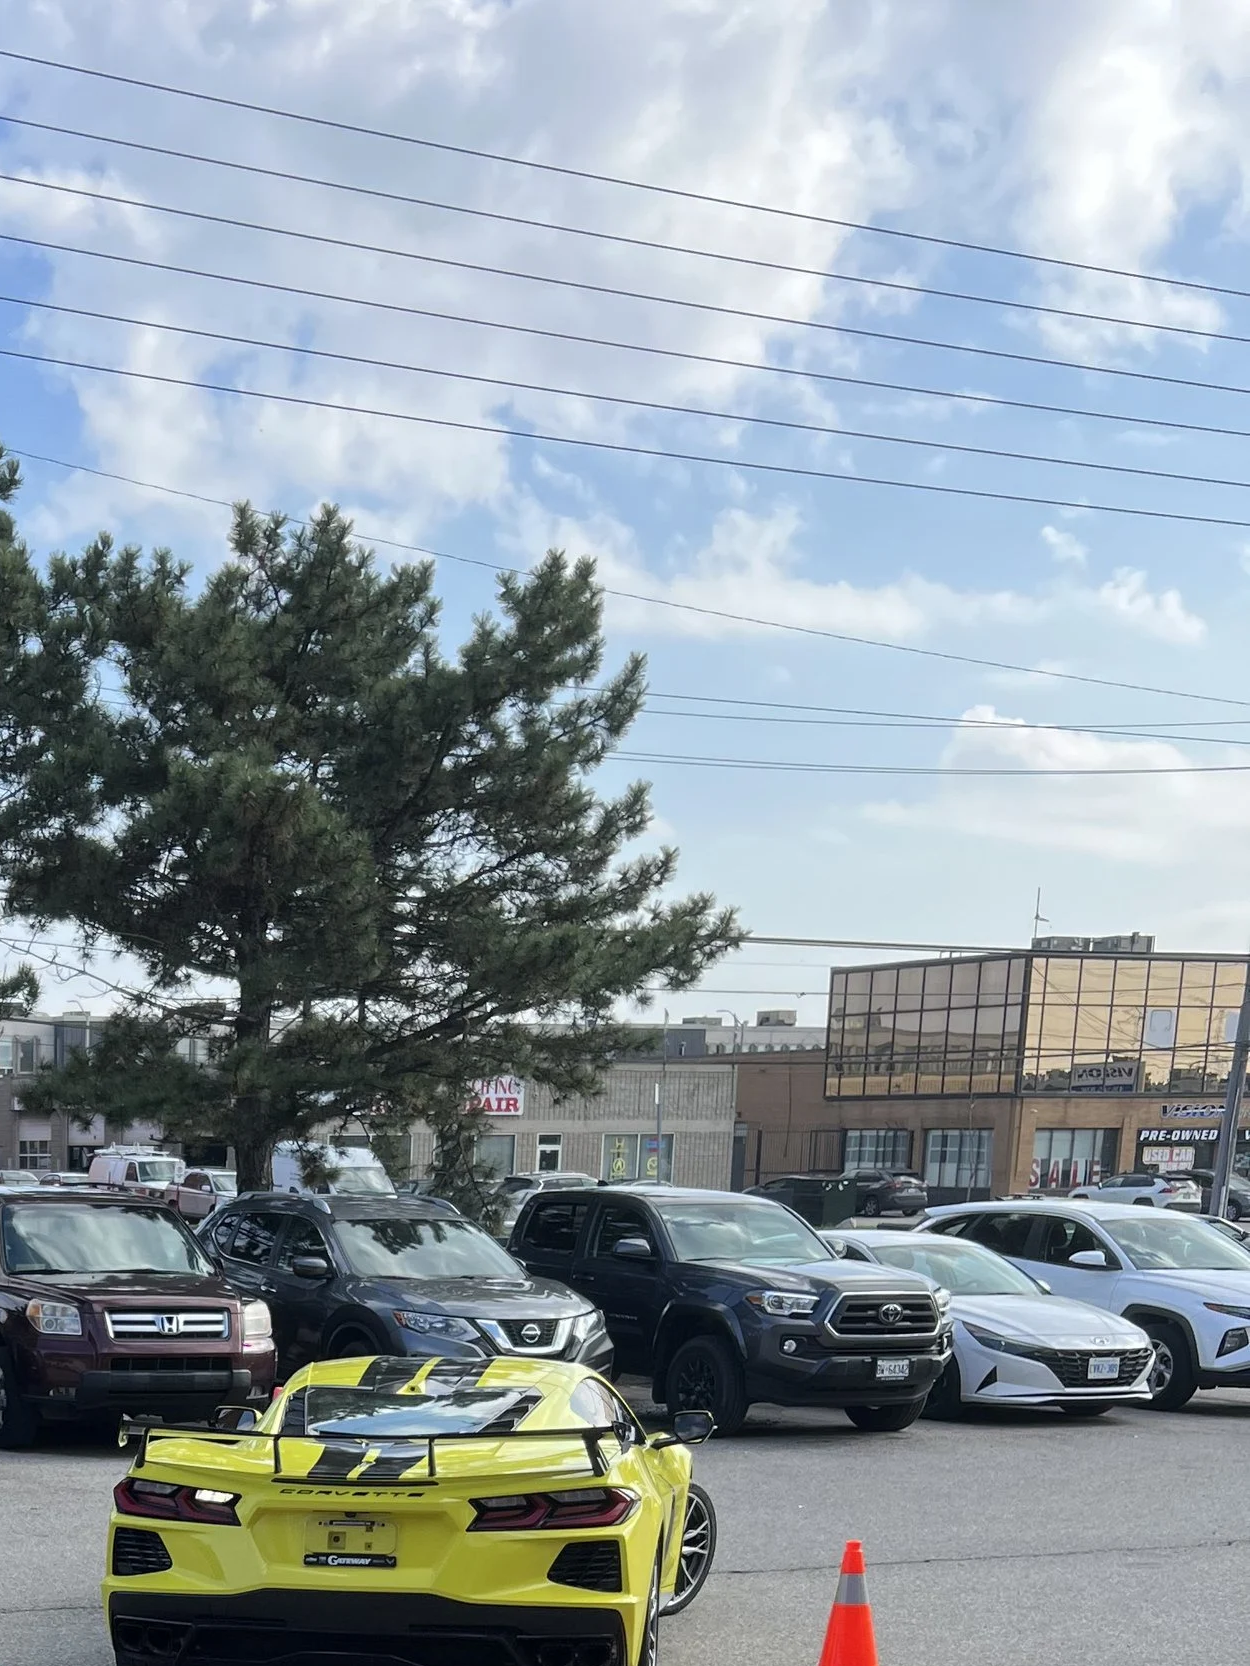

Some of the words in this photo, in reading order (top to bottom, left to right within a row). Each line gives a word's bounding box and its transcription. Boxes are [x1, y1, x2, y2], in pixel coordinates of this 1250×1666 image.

[1140, 1129, 1218, 1141] PRE-OWNED
[1028, 1159, 1100, 1187] SALE
[279, 1488, 426, 1498] CORVETTE
[327, 1554, 372, 1566] GATEWAY
